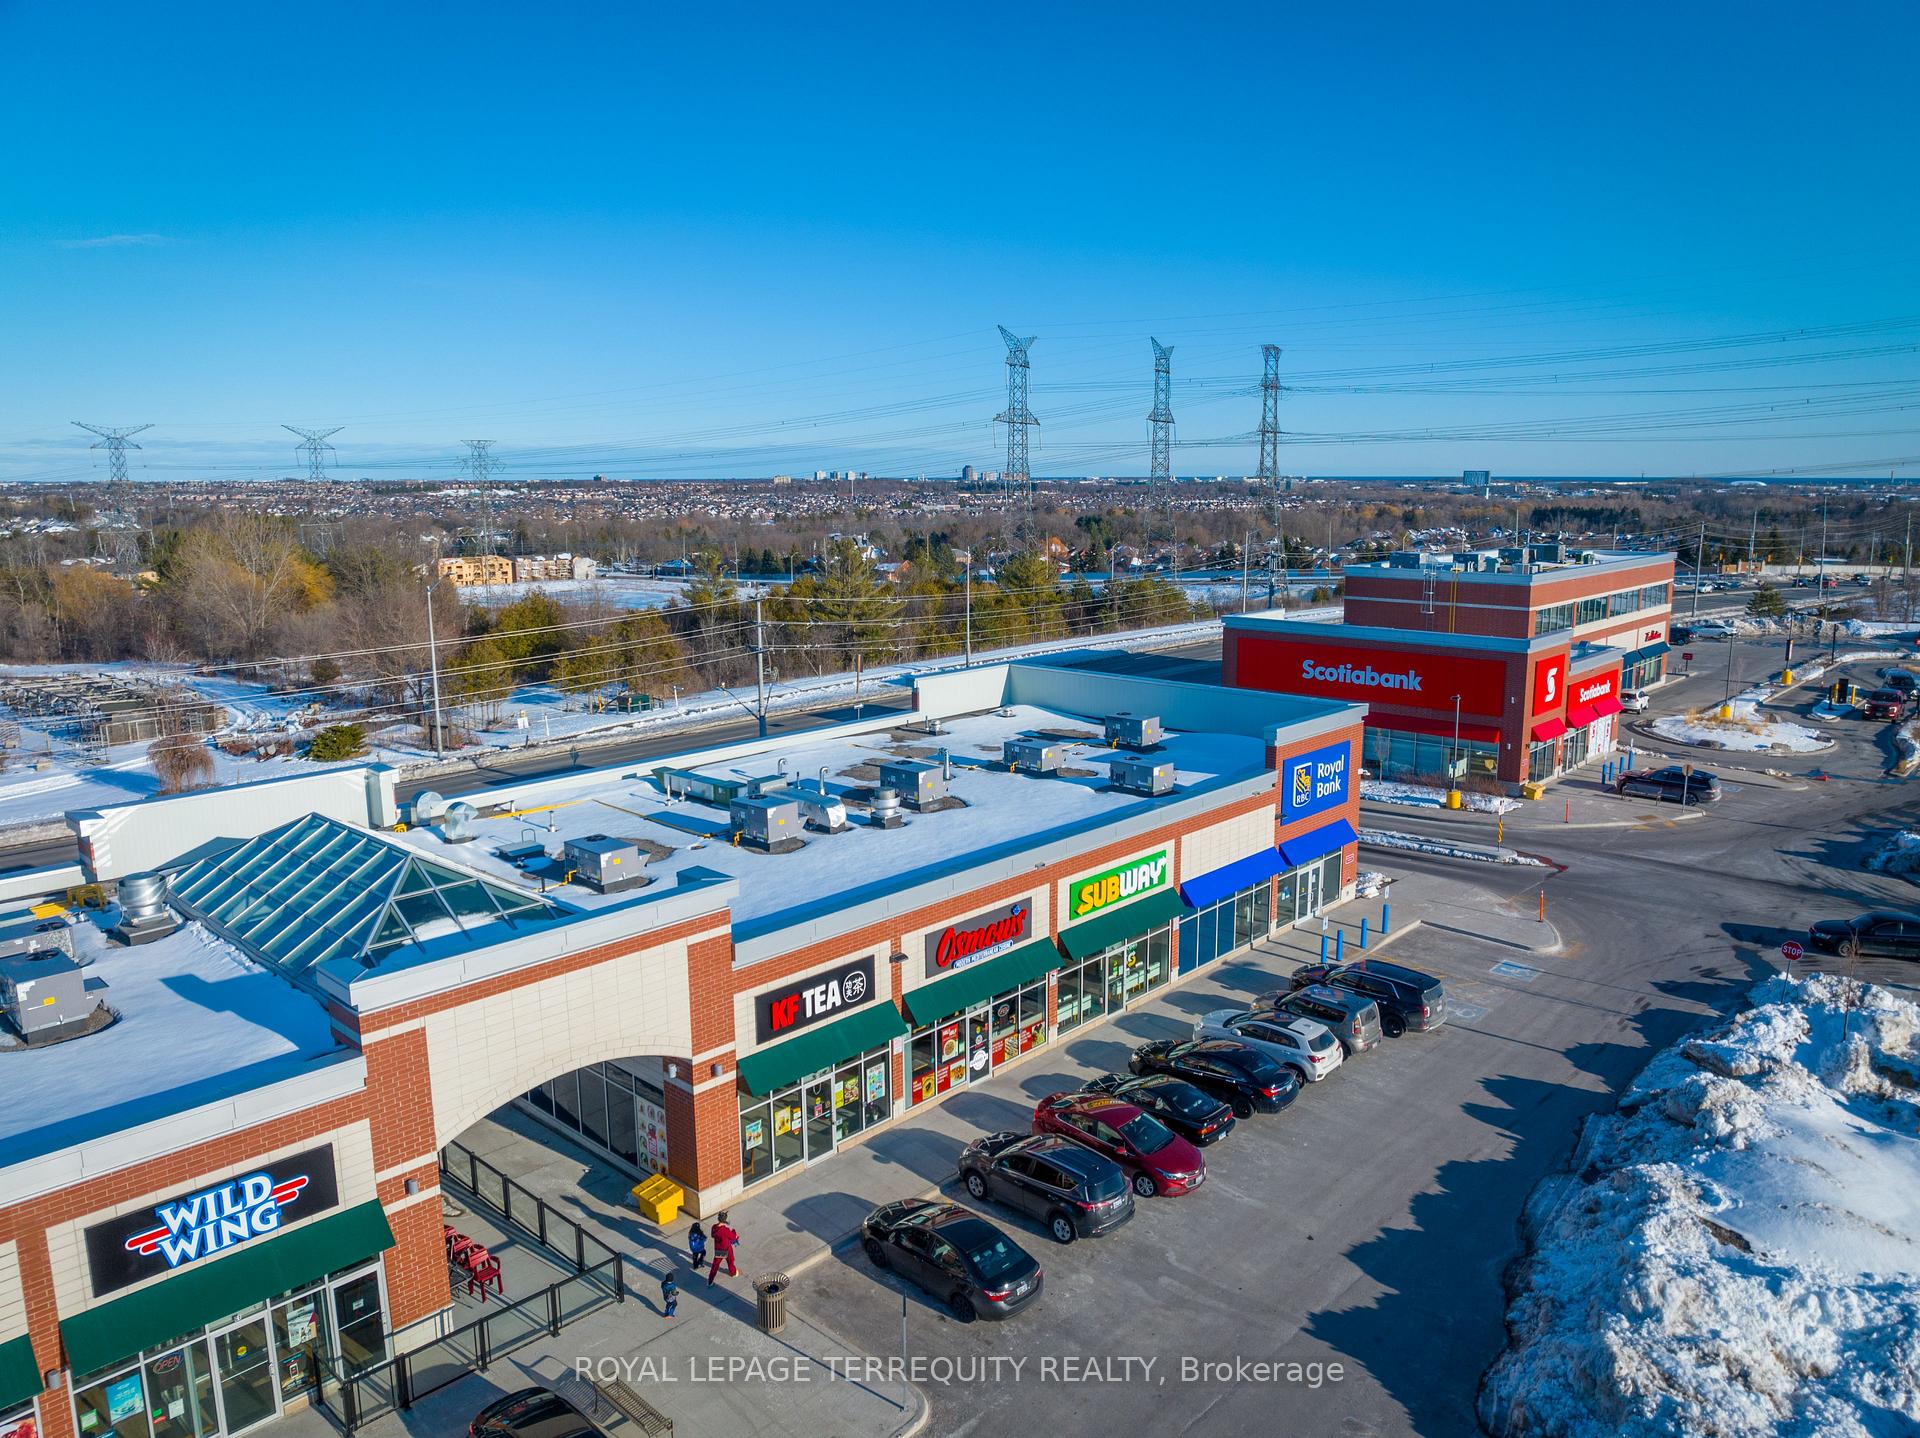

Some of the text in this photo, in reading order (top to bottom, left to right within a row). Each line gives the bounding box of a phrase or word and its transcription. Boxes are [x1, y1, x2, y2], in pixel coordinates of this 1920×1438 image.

[1302, 659, 1423, 691] Scotiabank
[1580, 680, 1611, 703] Scotiabank
[1317, 754, 1345, 779] Royal
[1296, 792, 1310, 804] RBC
[1316, 775, 1342, 798] Bank
[1075, 856, 1167, 916] SUBWAY
[1783, 945, 1802, 956] STOP
[771, 979, 842, 1032] KF TEA
[157, 1173, 274, 1236] WILD
[157, 1199, 280, 1268] WING
[156, 1354, 182, 1373] OPEN
